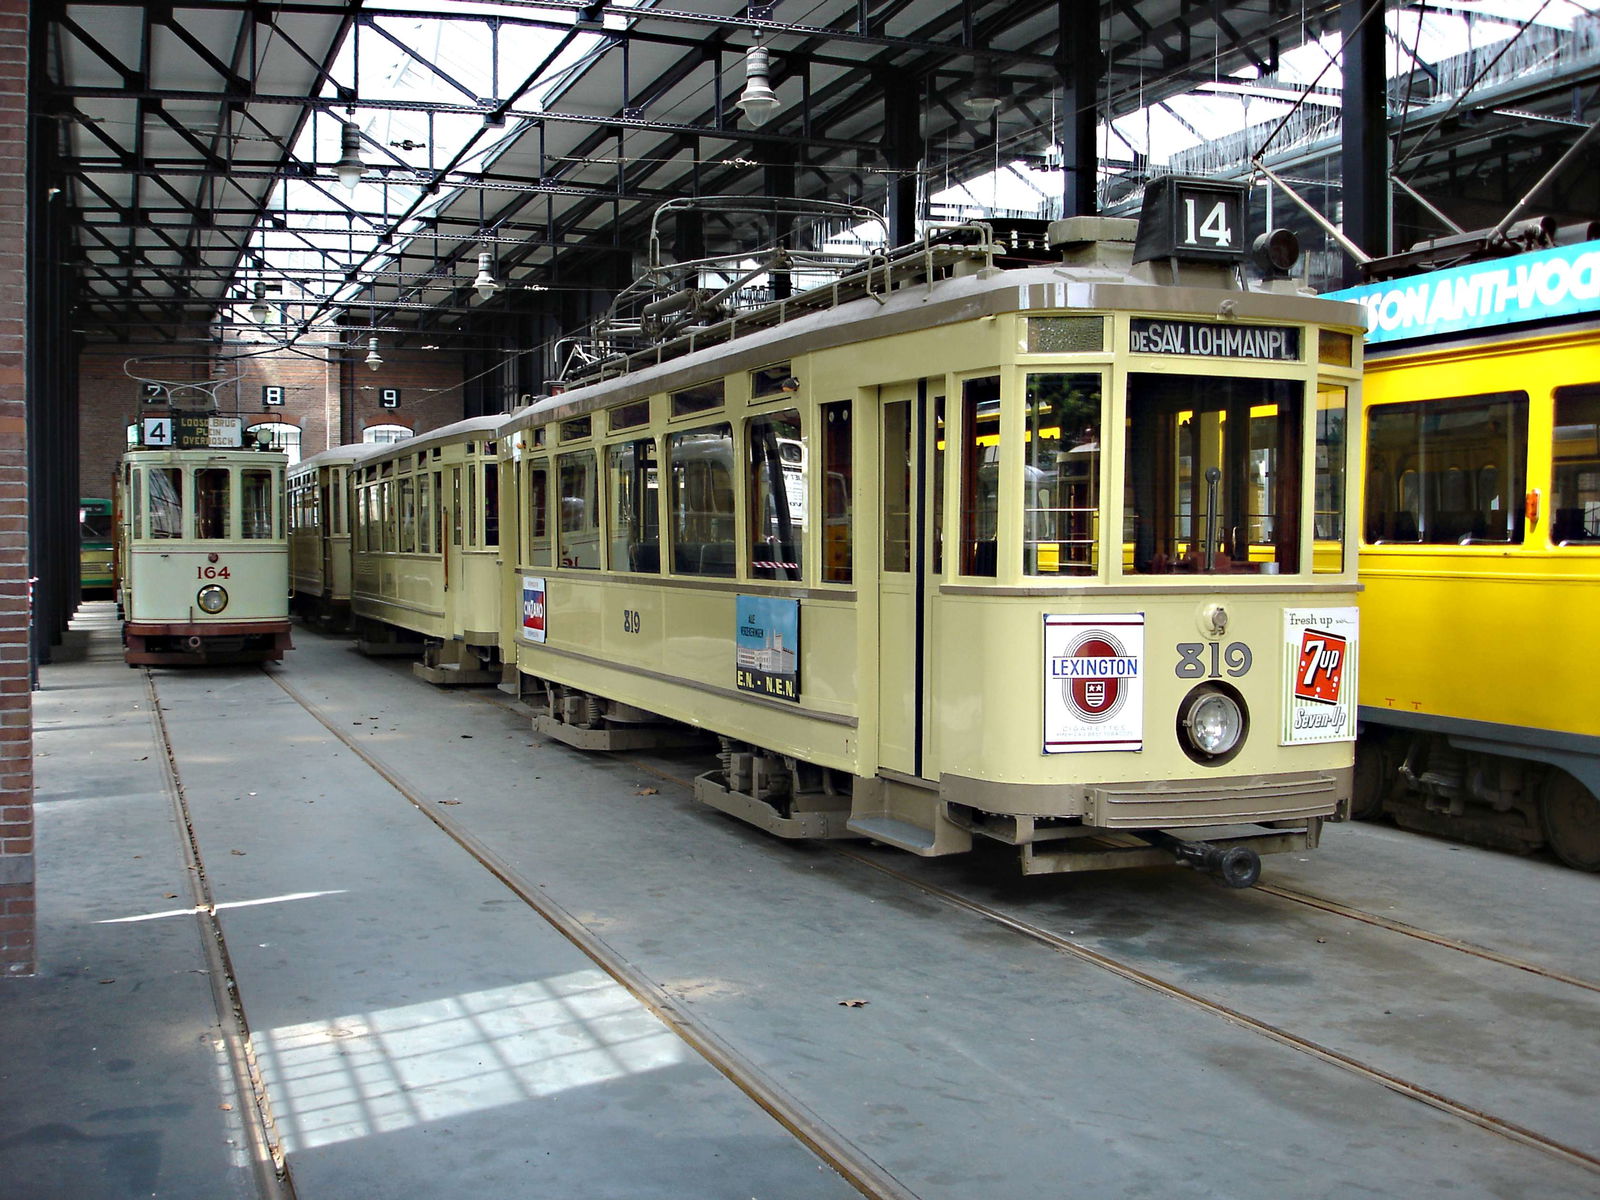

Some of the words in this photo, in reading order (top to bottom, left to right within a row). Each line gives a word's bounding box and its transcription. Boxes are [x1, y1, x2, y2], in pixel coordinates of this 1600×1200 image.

[1184, 198, 1231, 247] 14
[147, 384, 161, 404] 7
[266, 386, 281, 405] 8
[383, 389, 397, 408] 9
[149, 422, 166, 443] 4
[197, 566, 230, 580] 164
[624, 609, 640, 634] 819
[1289, 612, 1317, 625] fresh
[1319, 617, 1333, 628] up
[1052, 659, 1138, 676] LEXINGTON
[1175, 641, 1253, 679] 819
[1294, 706, 1347, 734] Seven-Up
